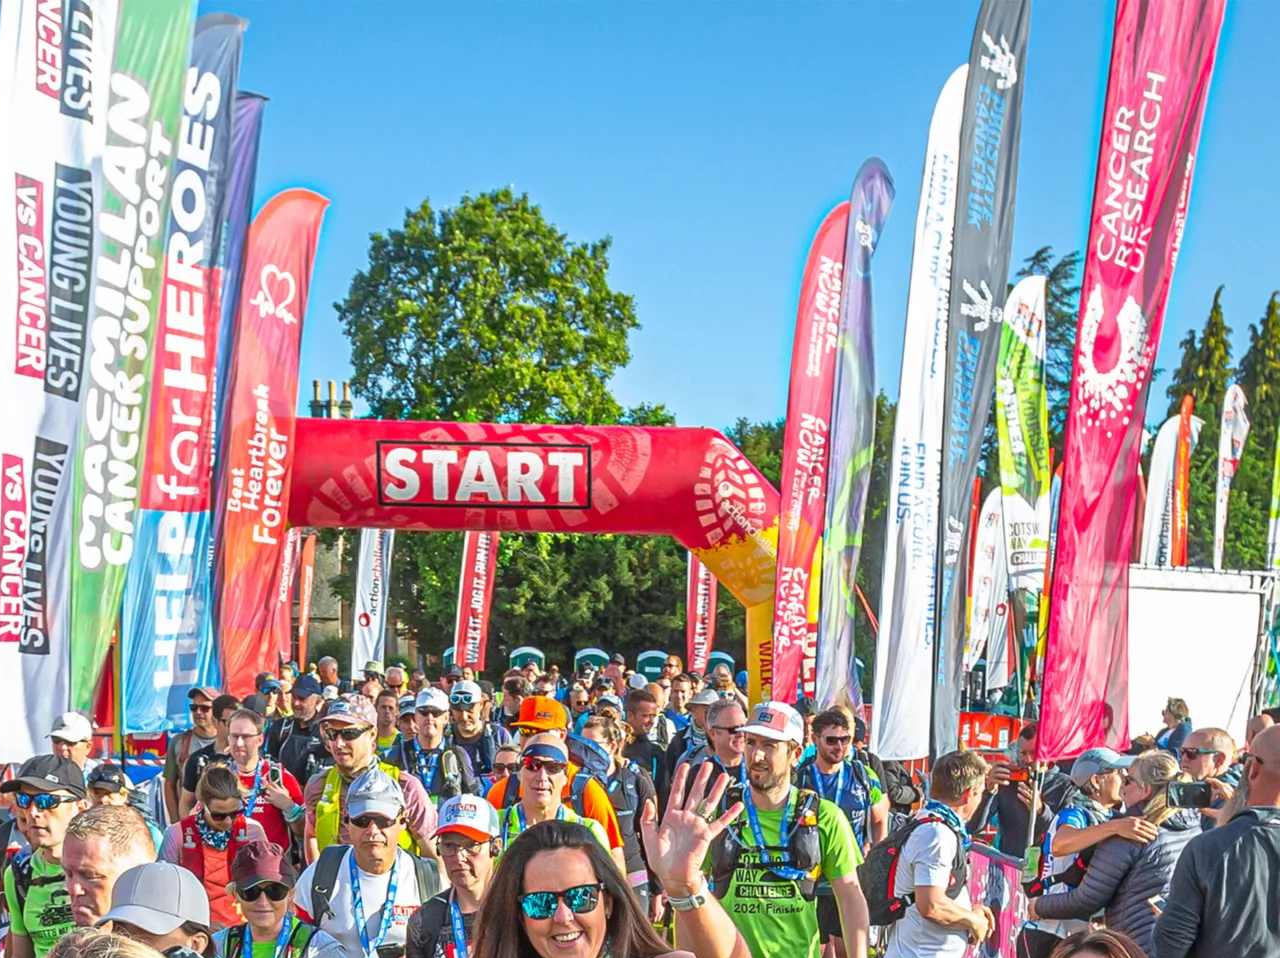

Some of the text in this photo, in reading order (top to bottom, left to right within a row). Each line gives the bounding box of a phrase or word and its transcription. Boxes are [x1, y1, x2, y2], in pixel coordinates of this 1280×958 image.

[971, 84, 992, 190] CANCER
[986, 90, 1006, 227] PROSTATE
[1097, 105, 1135, 262] CANCER
[1114, 71, 1166, 269] RESEARCH
[15, 184, 47, 373] vs CANCER
[163, 66, 221, 392] HEROES
[47, 172, 92, 393] YOUNG LIVES
[79, 72, 152, 569] MACMILLAN
[814, 255, 836, 315] NOW
[102, 119, 171, 566] CANCER SUPPORT
[4, 464, 23, 502] vs
[157, 398, 202, 501] for
[228, 468, 245, 513] Beat
[242, 383, 270, 511] Heartbreak
[252, 428, 288, 545] Forever
[384, 447, 584, 504] START
[795, 412, 816, 467] NOW
[807, 416, 827, 506] CANCER
[20, 450, 67, 650] YOUNG LIVES
[896, 494, 912, 525] US.
[153, 511, 197, 690] HELP
[466, 628, 481, 664] WALK
[471, 591, 485, 613] JOG
[693, 635, 708, 669] WALK
[733, 903, 762, 914] 2021
[735, 870, 759, 883] WAY
[739, 886, 793, 899] CHALLENGE
